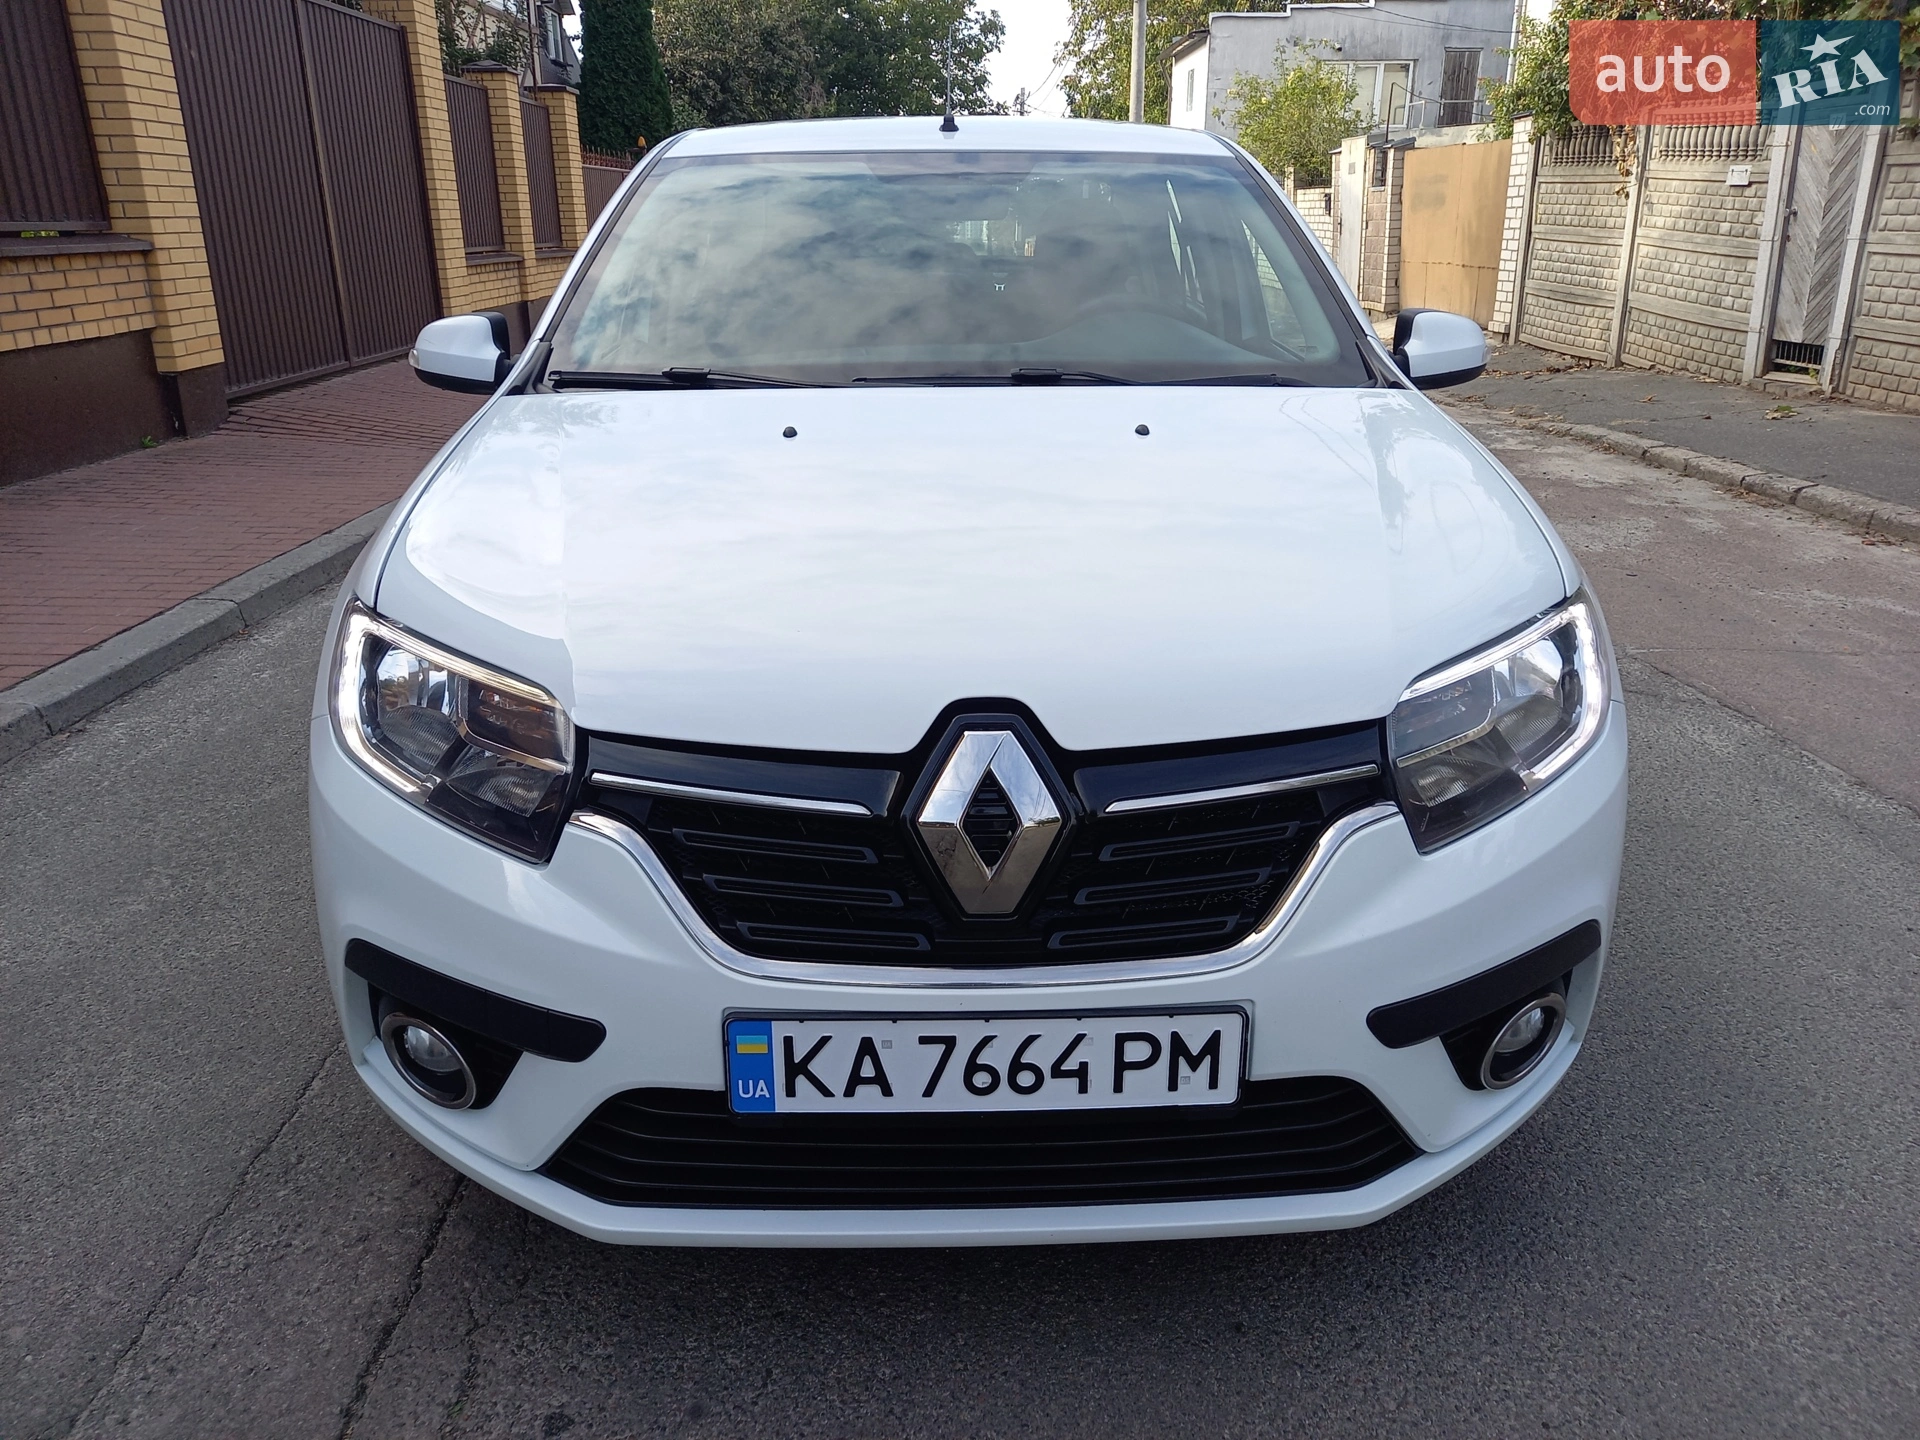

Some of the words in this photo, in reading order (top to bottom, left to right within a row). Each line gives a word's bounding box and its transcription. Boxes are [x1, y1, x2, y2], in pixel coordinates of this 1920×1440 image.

[783, 1035, 895, 1098] KA
[918, 1033, 1089, 1098] 7664
[1112, 1030, 1222, 1094] PM
[738, 1079, 770, 1098] UA
